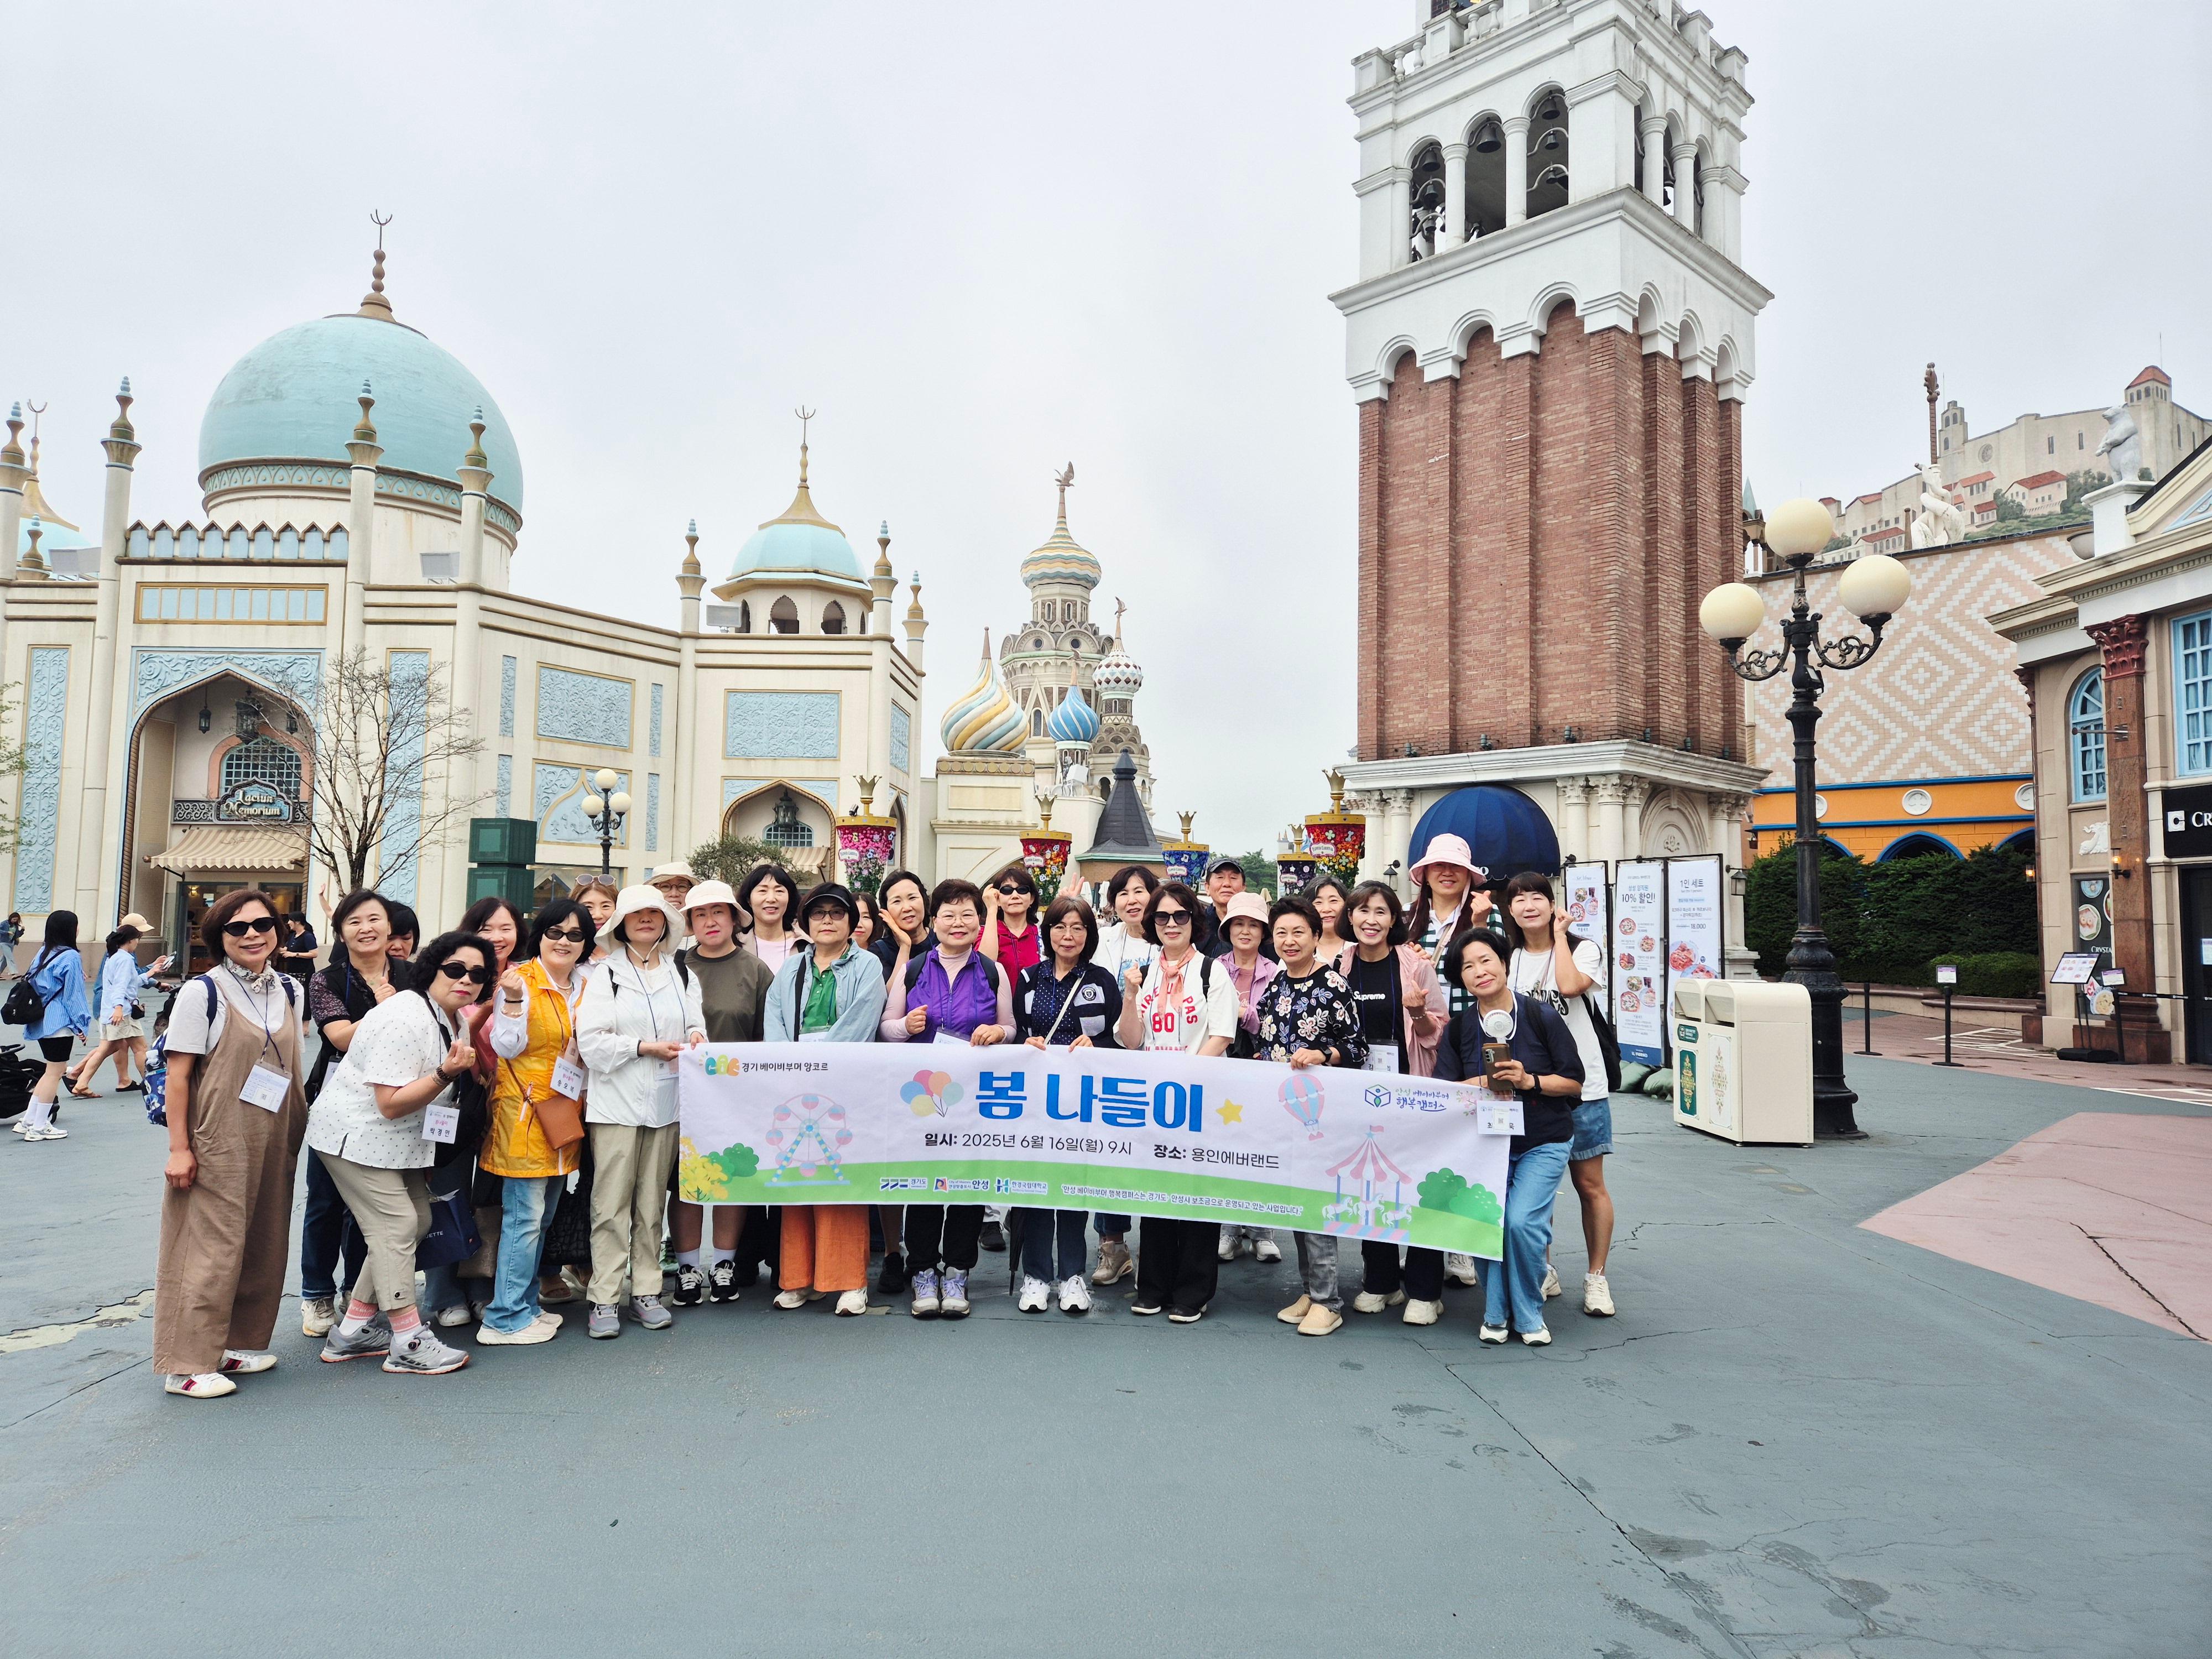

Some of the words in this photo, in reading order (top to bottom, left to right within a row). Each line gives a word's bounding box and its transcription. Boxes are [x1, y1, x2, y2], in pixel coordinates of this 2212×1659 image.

[223, 802, 281, 817] Memorium
[2192, 811, 2212, 827] CR
[1680, 879, 1689, 888] 1인
[1692, 879, 1704, 888] 세트
[1622, 894, 1636, 902] 10%
[1639, 893, 1655, 904] 할인!
[1353, 991, 1386, 1001] Supreme
[1152, 1013, 1175, 1032] 80
[742, 1062, 758, 1072] 경기
[760, 1062, 801, 1072] 베이비부머
[804, 1062, 828, 1072] 앙코르
[1395, 1088, 1410, 1096] 안성
[1413, 1089, 1449, 1099] 베이비부머
[975, 1071, 1027, 1120] 봄
[1046, 1073, 1203, 1132] 나들이
[1396, 1097, 1446, 1112] 행복캠퍼스
[925, 1133, 957, 1146] 일시:
[962, 1134, 1015, 1147] 2025년
[1020, 1135, 1044, 1149] 6월
[1048, 1137, 1104, 1153] 16일(월)
[1108, 1141, 1132, 1155] 9시
[1154, 1144, 1186, 1160] 장소:
[1191, 1148, 1279, 1168] 용인에버랜드
[972, 1180, 989, 1190] 안성
[1078, 1187, 1107, 1196] 베이비부머
[1109, 1191, 1146, 1199] 행복캠퍼스는
[1171, 1194, 1190, 1203] 안성시
[1192, 1197, 1223, 1206] 보조금으로
[1225, 1199, 1250, 1209] 운영되고
[1253, 1203, 1265, 1211] 있는
